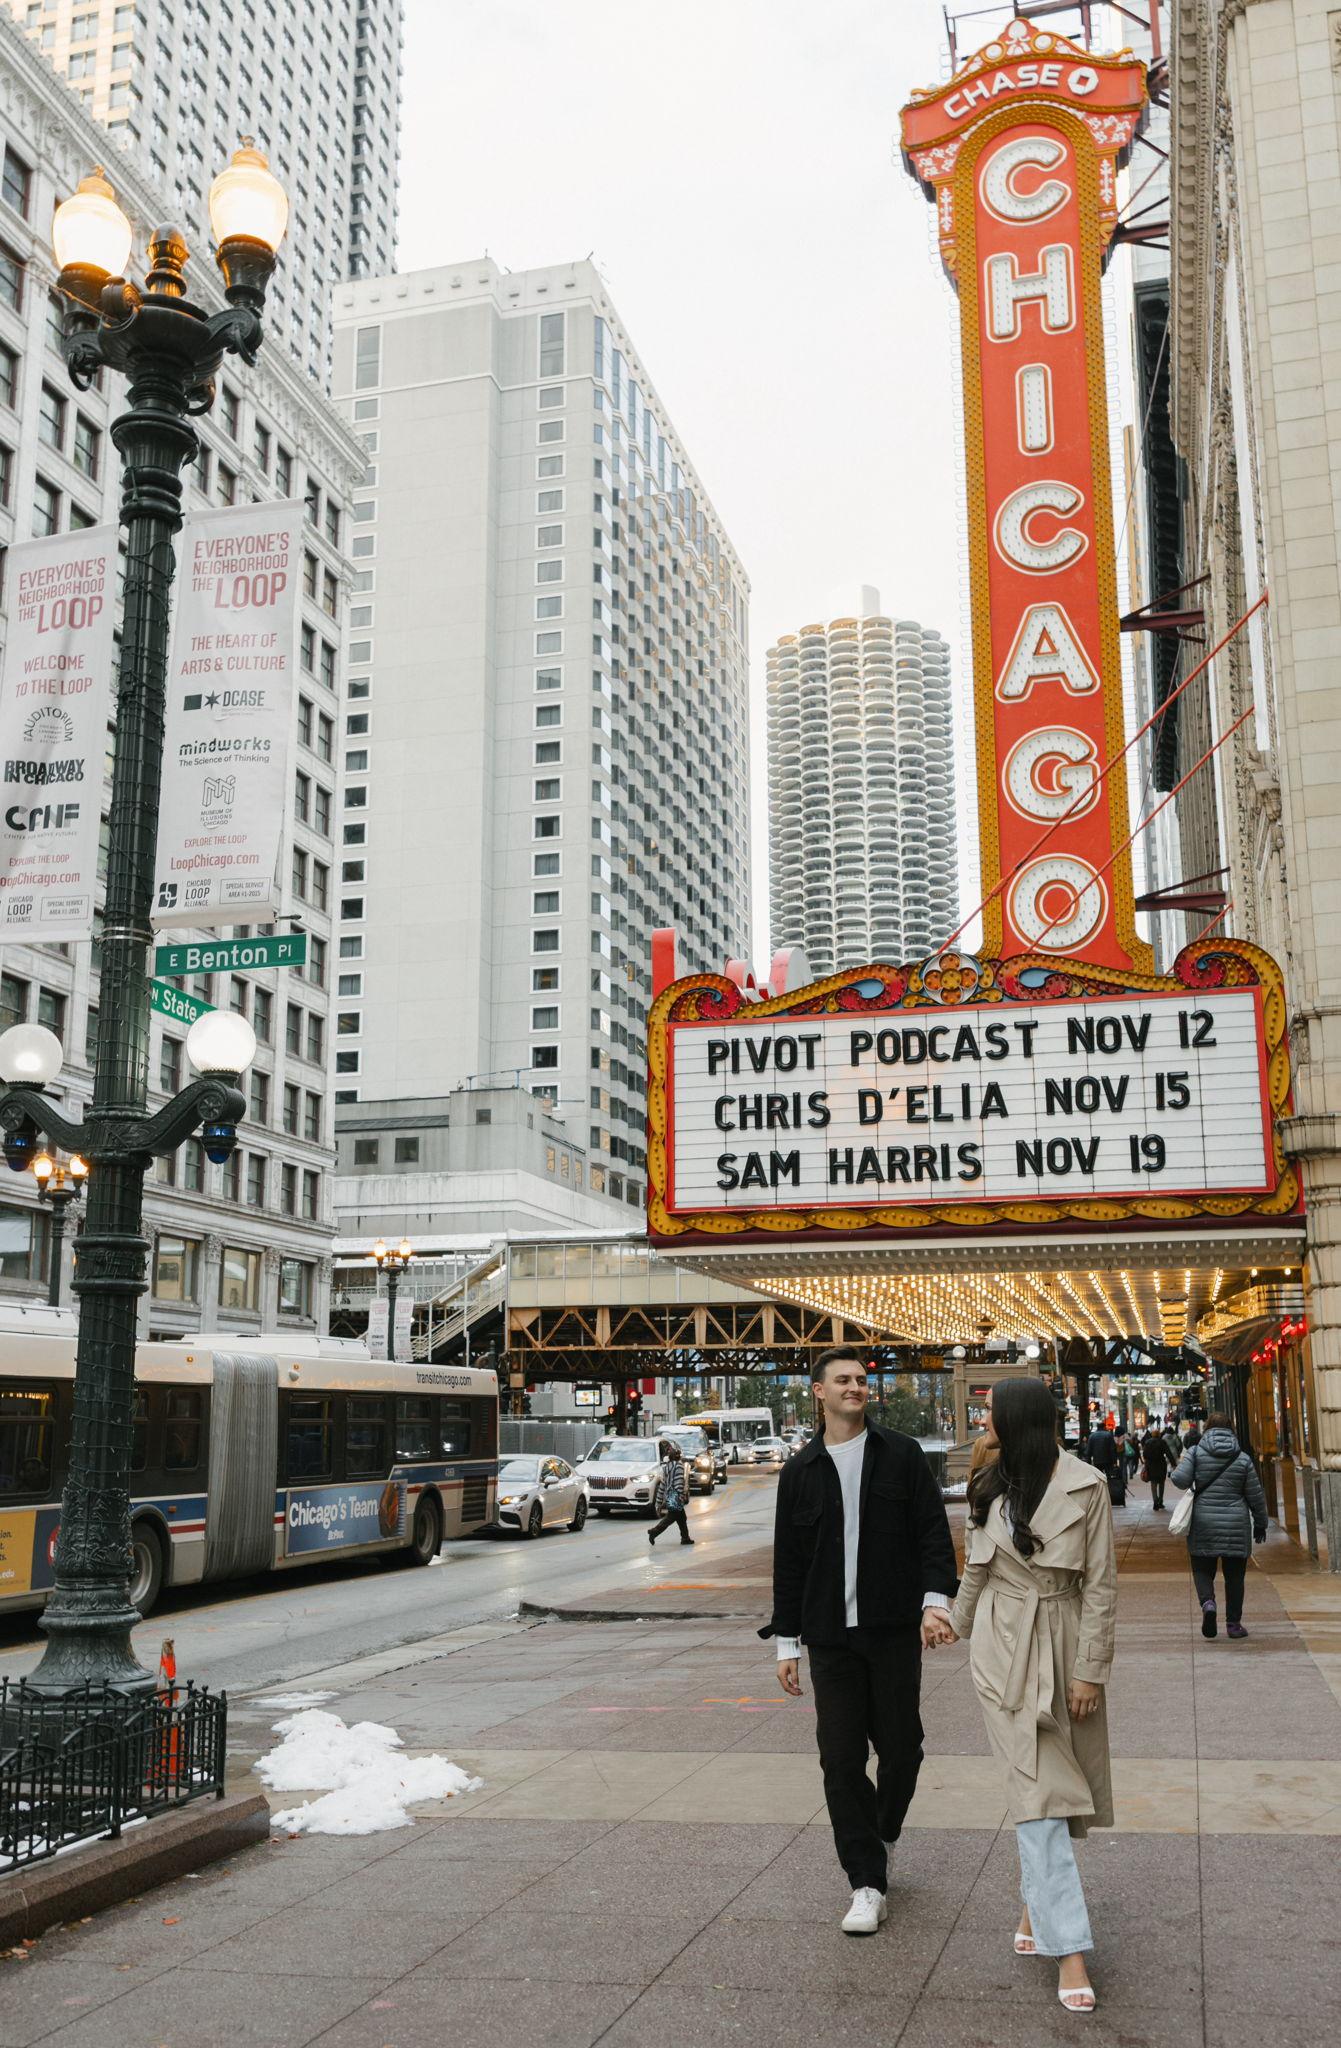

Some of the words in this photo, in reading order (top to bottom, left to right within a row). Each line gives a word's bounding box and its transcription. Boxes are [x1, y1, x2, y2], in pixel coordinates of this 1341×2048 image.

[943, 64, 1063, 119] CHASE
[194, 532, 289, 559] EVERYONE'S
[979, 136, 1108, 955] CHICAGO
[19, 557, 106, 591] EVERYONE'S
[193, 553, 288, 575] NEIGHBORHOOD
[18, 577, 105, 607] NEIGHBORHOOD
[192, 577, 214, 592] THE
[214, 572, 287, 609] LOOP
[18, 605, 37, 622] THE
[37, 596, 103, 634] LOOP
[191, 635, 213, 652] THE
[215, 634, 258, 649] HEART
[261, 633, 278, 648] OF
[24, 655, 85, 674] WELCOME
[181, 658, 211, 676] ARTS
[214, 657, 224, 671] &
[227, 655, 286, 671] CULTURE
[15, 682, 28, 698] TO
[31, 679, 57, 694] THE
[60, 677, 93, 696] LOOP
[222, 690, 265, 707] DCASE
[24, 706, 74, 742] AUDITORIUM
[179, 737, 271, 756] mindworks
[5, 758, 86, 777] BROADWAY
[179, 759, 193, 767] The
[193, 756, 222, 766] Science
[234, 754, 270, 763] Thinking
[3, 772, 20, 783] IN
[23, 772, 84, 785] CHICAGO
[184, 838, 212, 848] EXPLORE
[214, 836, 226, 845] THE
[227, 835, 247, 844] LOOP
[38, 855, 51, 864] THE
[52, 854, 70, 863] LOOP
[170, 854, 260, 872] LoopChicago.com
[186, 878, 212, 887] CHICAGO
[8, 895, 34, 903] CHICAGO
[184, 900, 208, 908] ALLIANCE
[185, 887, 210, 900] LOOP
[7, 904, 33, 916] LOOP
[170, 953, 178, 967] E
[186, 945, 268, 970] Benton
[278, 944, 292, 958] Pl
[151, 987, 159, 1000] N
[162, 989, 197, 1023] State
[707, 1033, 821, 1076] PIVOT
[850, 1020, 1039, 1067] PODCAST
[1067, 1012, 1152, 1055] NOV
[1178, 1009, 1218, 1049] 12
[714, 1090, 831, 1131] CHRIS
[859, 1081, 1009, 1126] D'ELIA
[1045, 1074, 1130, 1116] NOV
[1156, 1070, 1190, 1111] 15
[717, 1148, 801, 1191] SAM
[829, 1141, 983, 1185] HARRIS
[1016, 1135, 1100, 1178] NOV
[1129, 1133, 1167, 1174] 19
[416, 1372, 472, 1388] transitchicago.com
[289, 1498, 347, 1529] Chicago's
